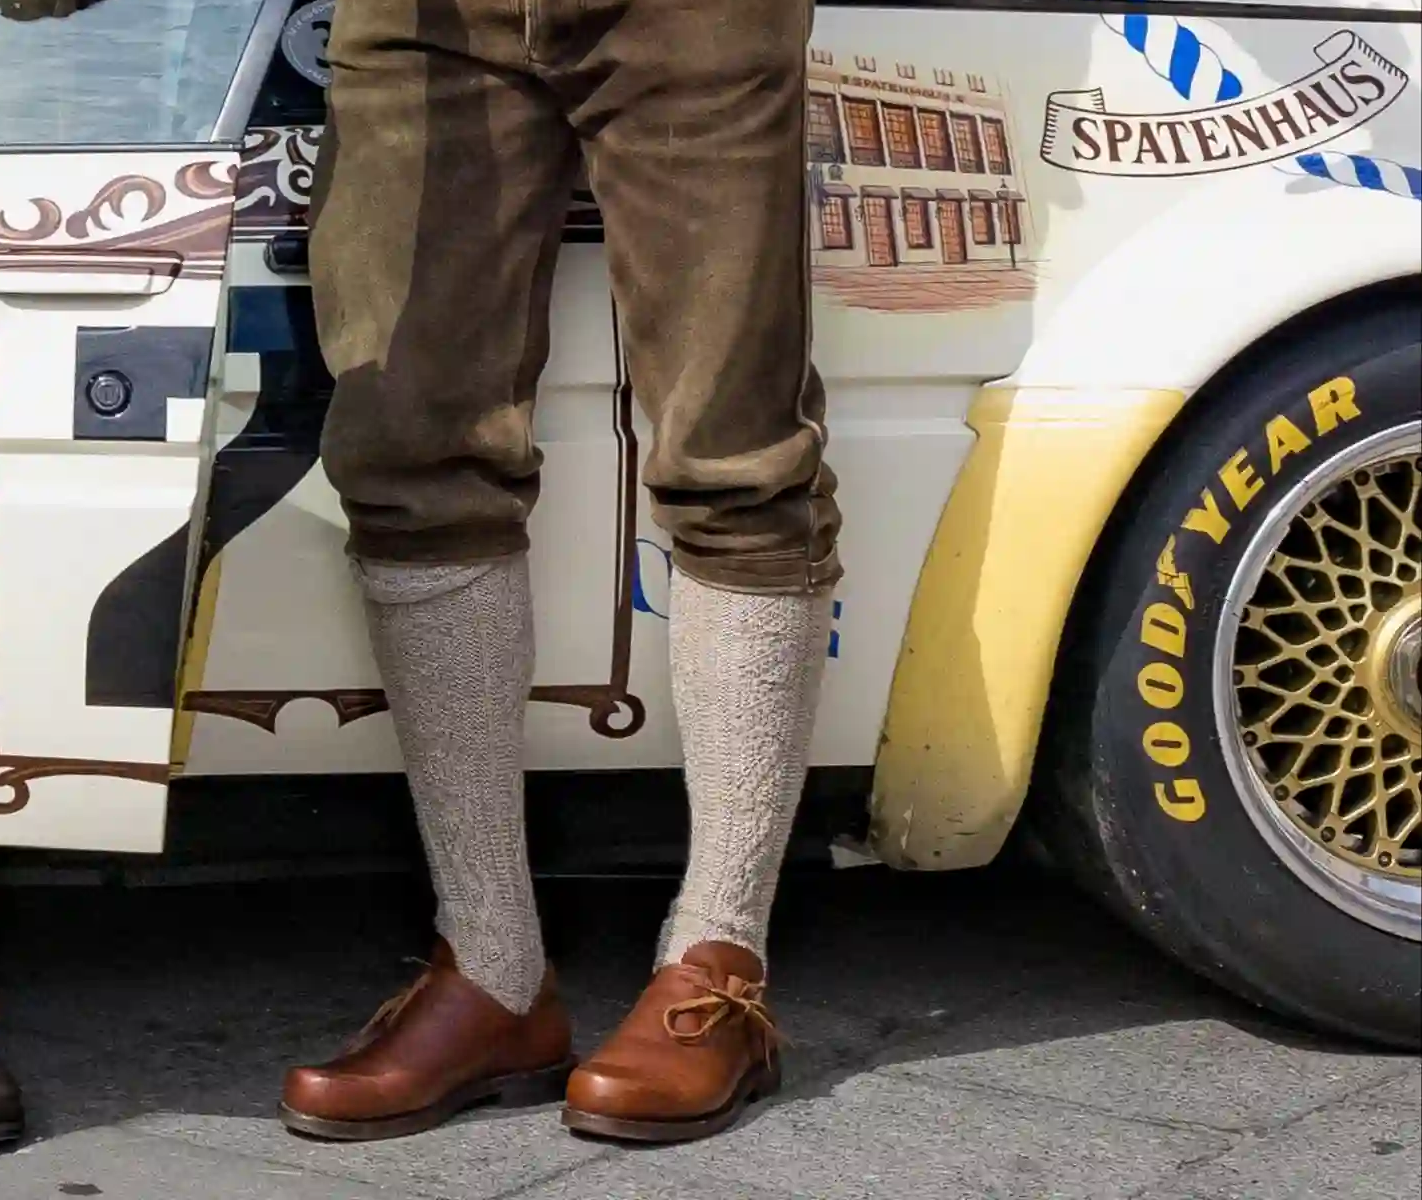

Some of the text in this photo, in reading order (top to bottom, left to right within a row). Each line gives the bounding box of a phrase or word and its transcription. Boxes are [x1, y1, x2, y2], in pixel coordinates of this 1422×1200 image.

[1071, 59, 1387, 165] SPATENHAUS
[1136, 375, 1362, 822] GOOD YEAR
